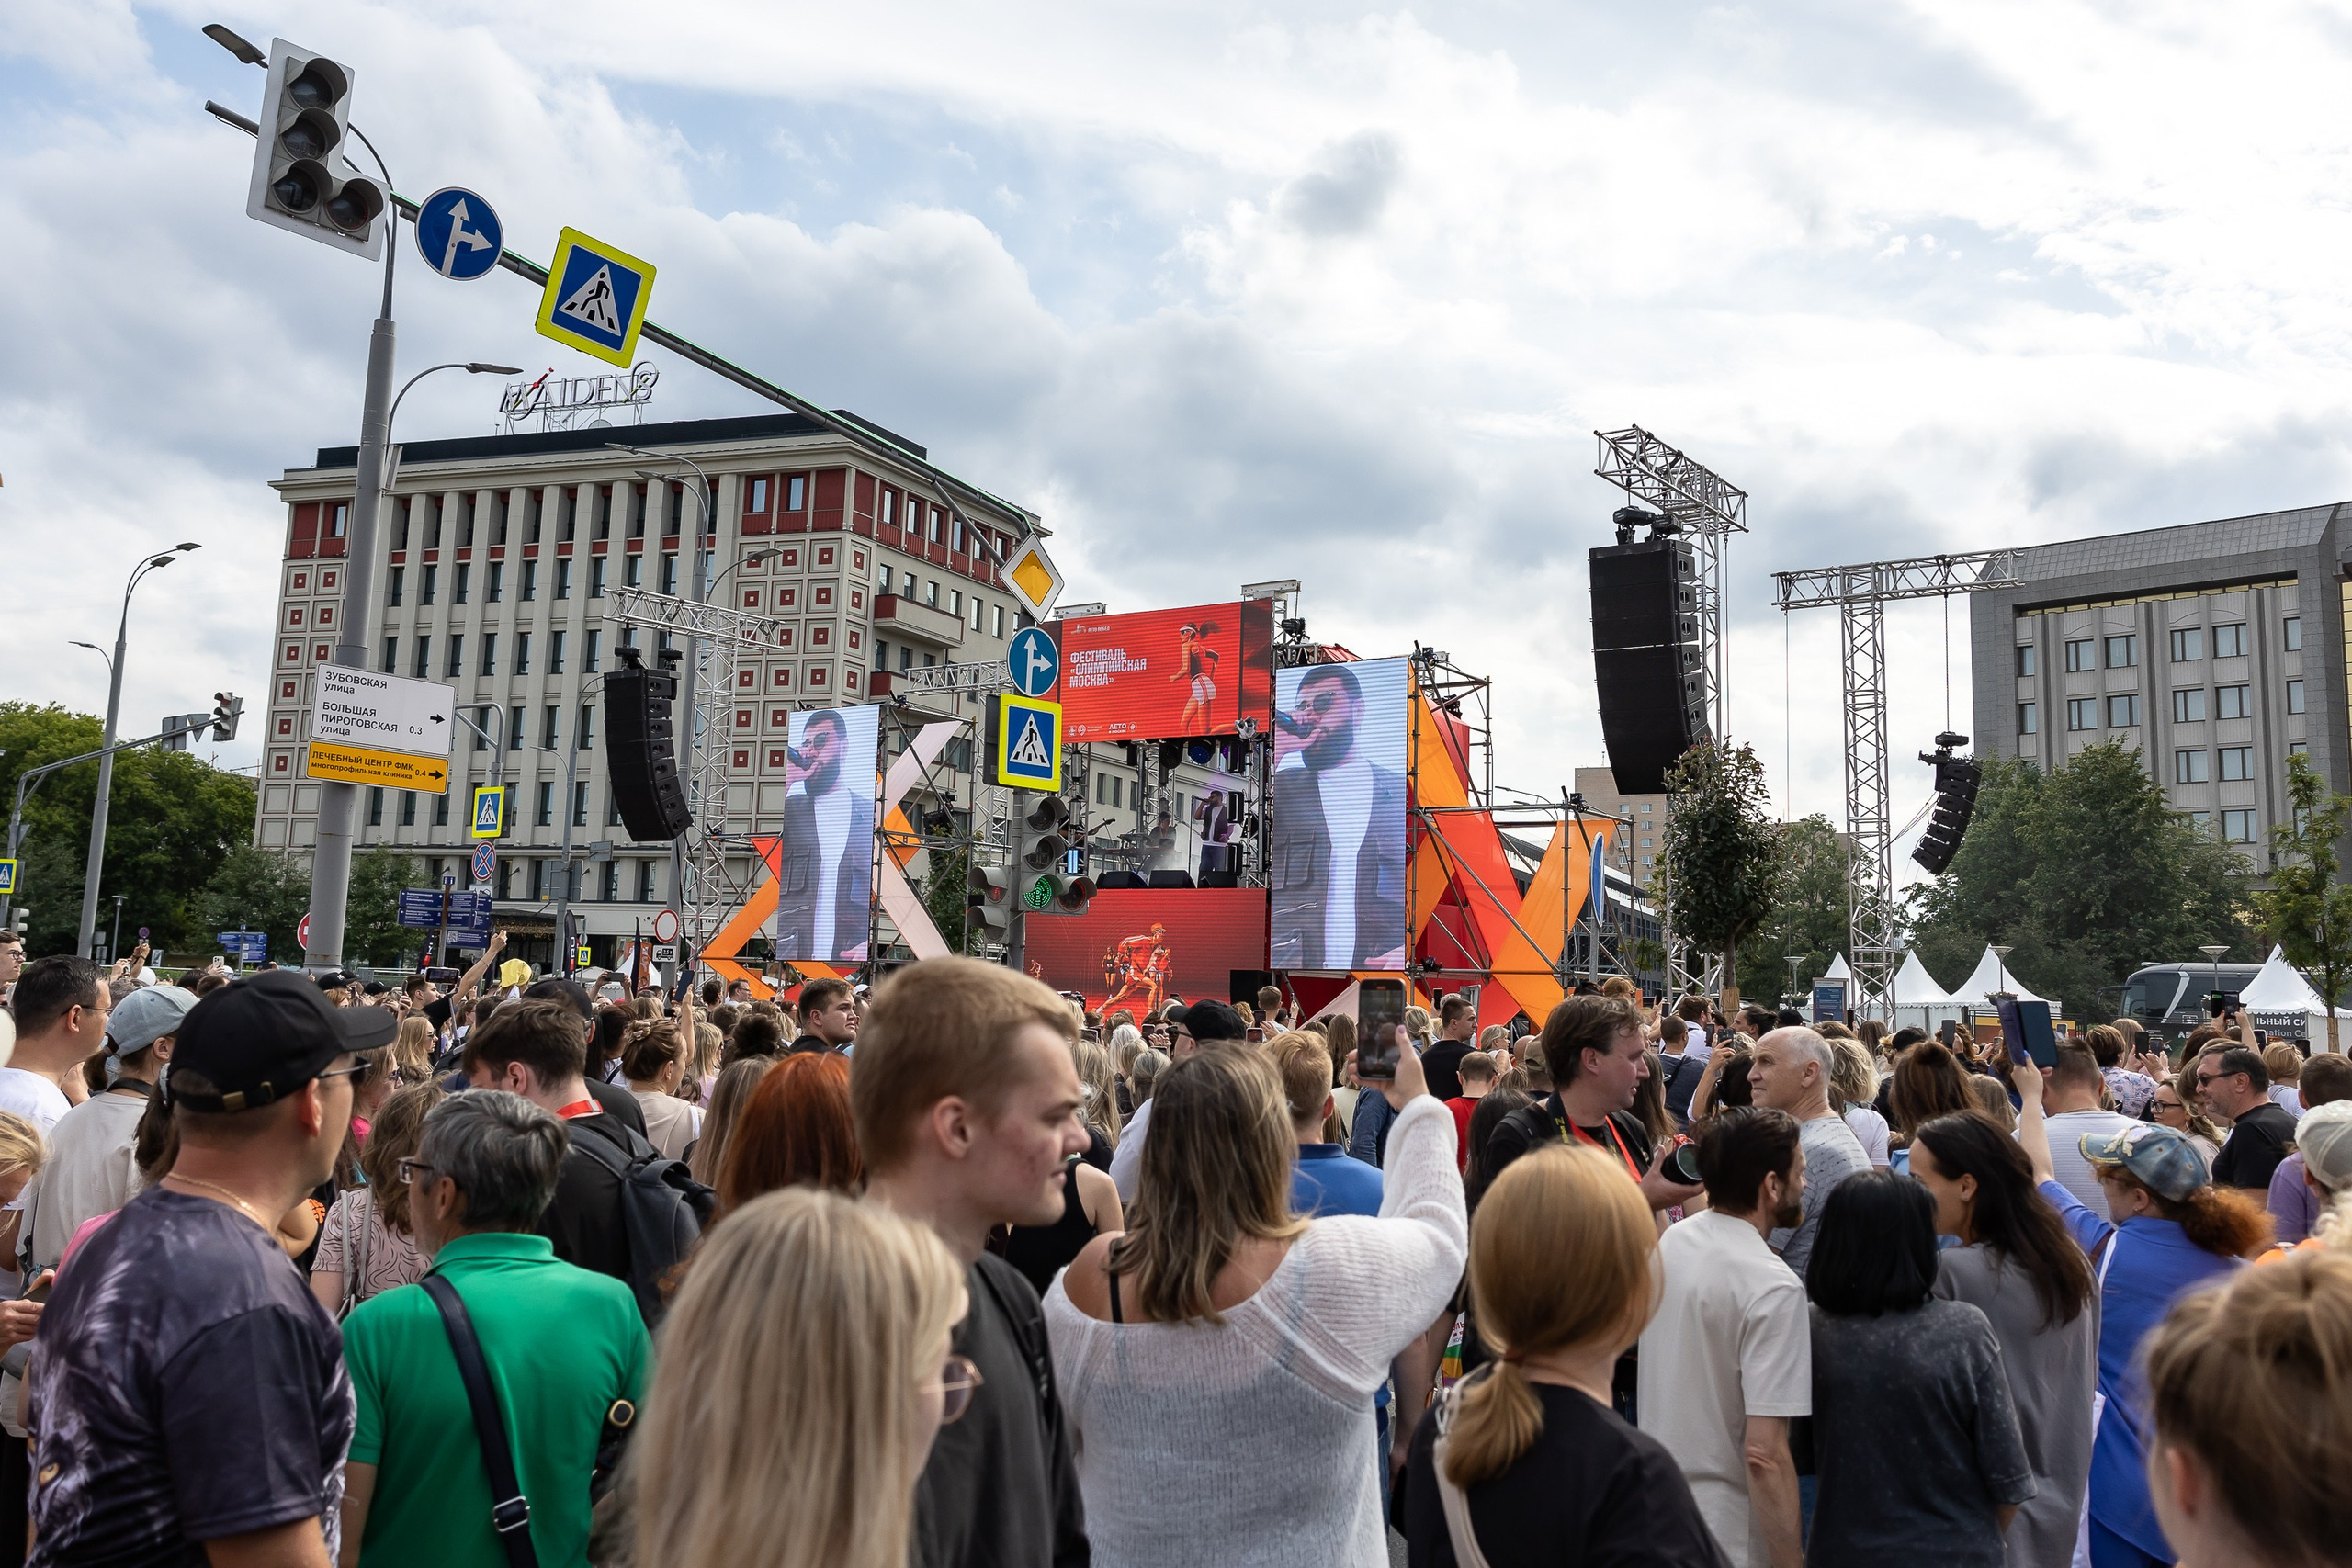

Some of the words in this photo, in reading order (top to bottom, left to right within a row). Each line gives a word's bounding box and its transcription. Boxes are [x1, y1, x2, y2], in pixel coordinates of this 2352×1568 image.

[499, 360, 660, 421] MAIDENS
[1069, 648, 1126, 663] ФЕСТИВАЛЬ
[1069, 658, 1147, 675] «ОЛИМПИЙСКАЯ
[324, 682, 355, 694] улица
[325, 671, 388, 689] ЗУБОВСКАЯ
[1069, 673, 1114, 688] МОСКВА»
[322, 701, 377, 717] БОЛЬШАЯ
[320, 725, 351, 736] улица
[322, 713, 398, 732] ПИРОГОВСКАЯ
[409, 725, 423, 735] 0.3
[311, 750, 363, 764] ЛЕЧЕБНЫЙ
[364, 758, 392, 768] ЦЕНТР
[394, 761, 413, 771] ФМК
[311, 761, 381, 776] многопрофильная
[382, 771, 413, 780] клиника
[414, 769, 426, 777] 0.4
